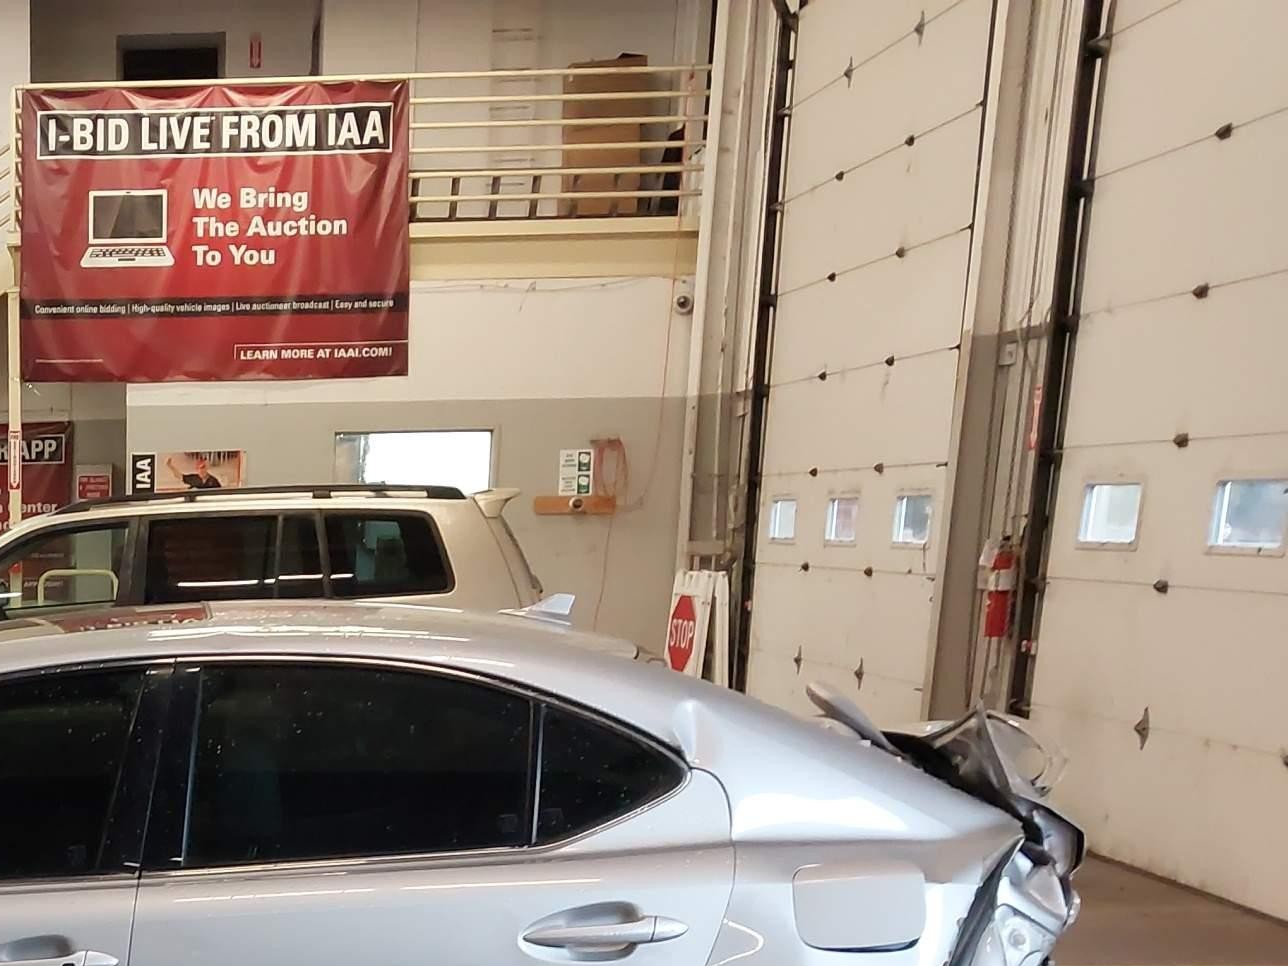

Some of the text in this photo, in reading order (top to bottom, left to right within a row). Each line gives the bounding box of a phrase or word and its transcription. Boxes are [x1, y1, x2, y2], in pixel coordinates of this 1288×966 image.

[47, 110, 386, 152] I-BID LIVE FROM IAA
[192, 186, 308, 212] We Bring
[192, 214, 347, 238] The Auction
[191, 244, 276, 266] To You
[34, 303, 126, 315] Convenient online bidding
[131, 302, 230, 314] High-quality vehicle images
[235, 300, 330, 311] Live auctioneer broadcast
[335, 299, 394, 311] Easy and secure
[240, 349, 278, 361] LEARN
[281, 348, 314, 360] MORE
[317, 347, 332, 359] AT
[20, 439, 57, 460] APP
[135, 458, 152, 489] IAA
[8, 502, 58, 515] enter
[669, 618, 695, 650] STOP
